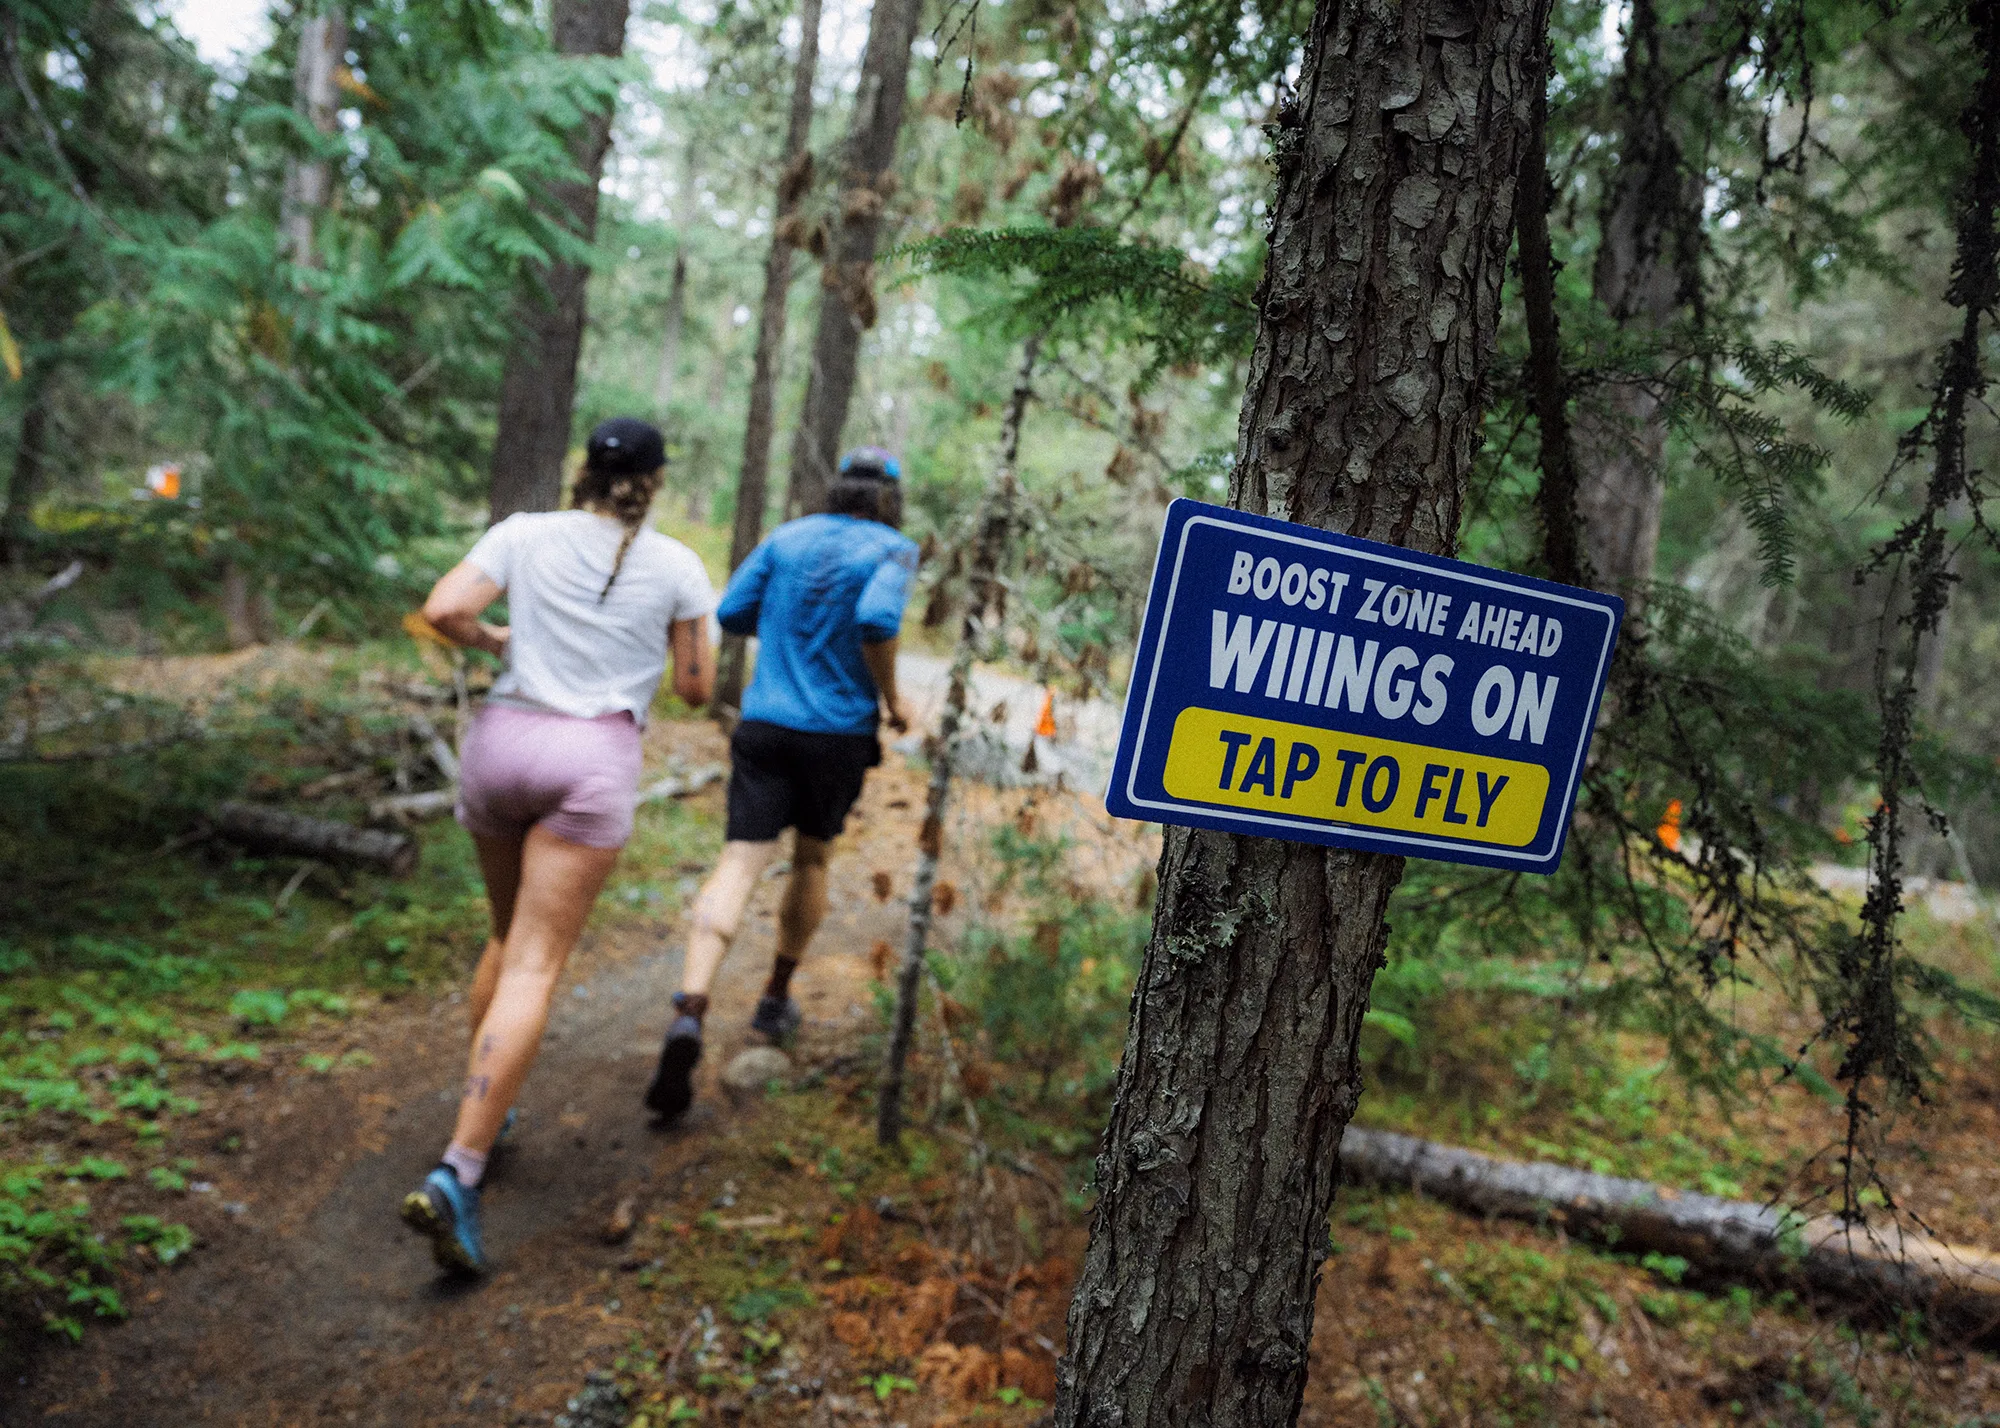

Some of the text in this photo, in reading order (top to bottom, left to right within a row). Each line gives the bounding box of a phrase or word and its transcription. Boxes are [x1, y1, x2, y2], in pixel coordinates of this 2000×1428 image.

[1227, 550, 1563, 658] BOOST ZONE AHEAD
[1208, 609, 1560, 745] WIIINGS ON
[1219, 729, 1510, 828] TAP TO FLY
